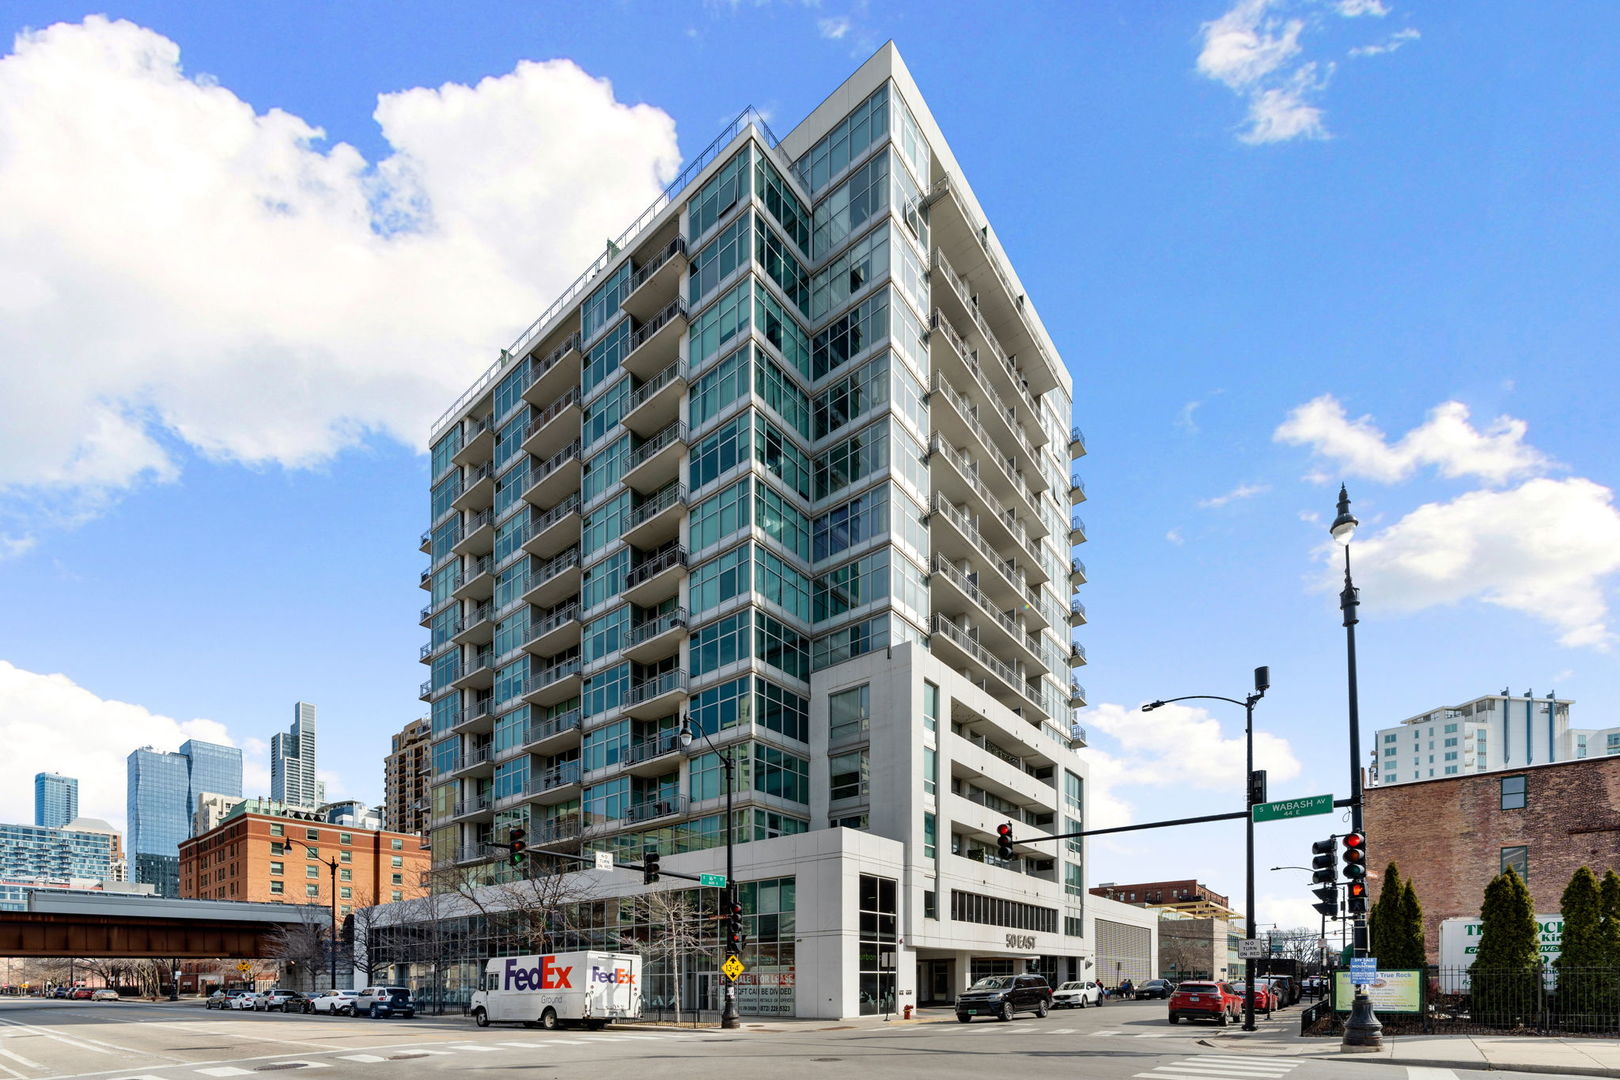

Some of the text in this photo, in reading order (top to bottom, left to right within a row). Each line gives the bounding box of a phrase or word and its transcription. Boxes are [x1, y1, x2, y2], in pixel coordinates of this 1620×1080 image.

[1272, 800, 1313, 812] WABASH
[1006, 934, 1037, 949] 50 EAST
[504, 956, 573, 991] FedEx
[592, 966, 636, 985] FedEx
[771, 974, 793, 984] LEASE
[770, 987, 792, 996] DIVDED
[541, 995, 563, 1004] Ground
